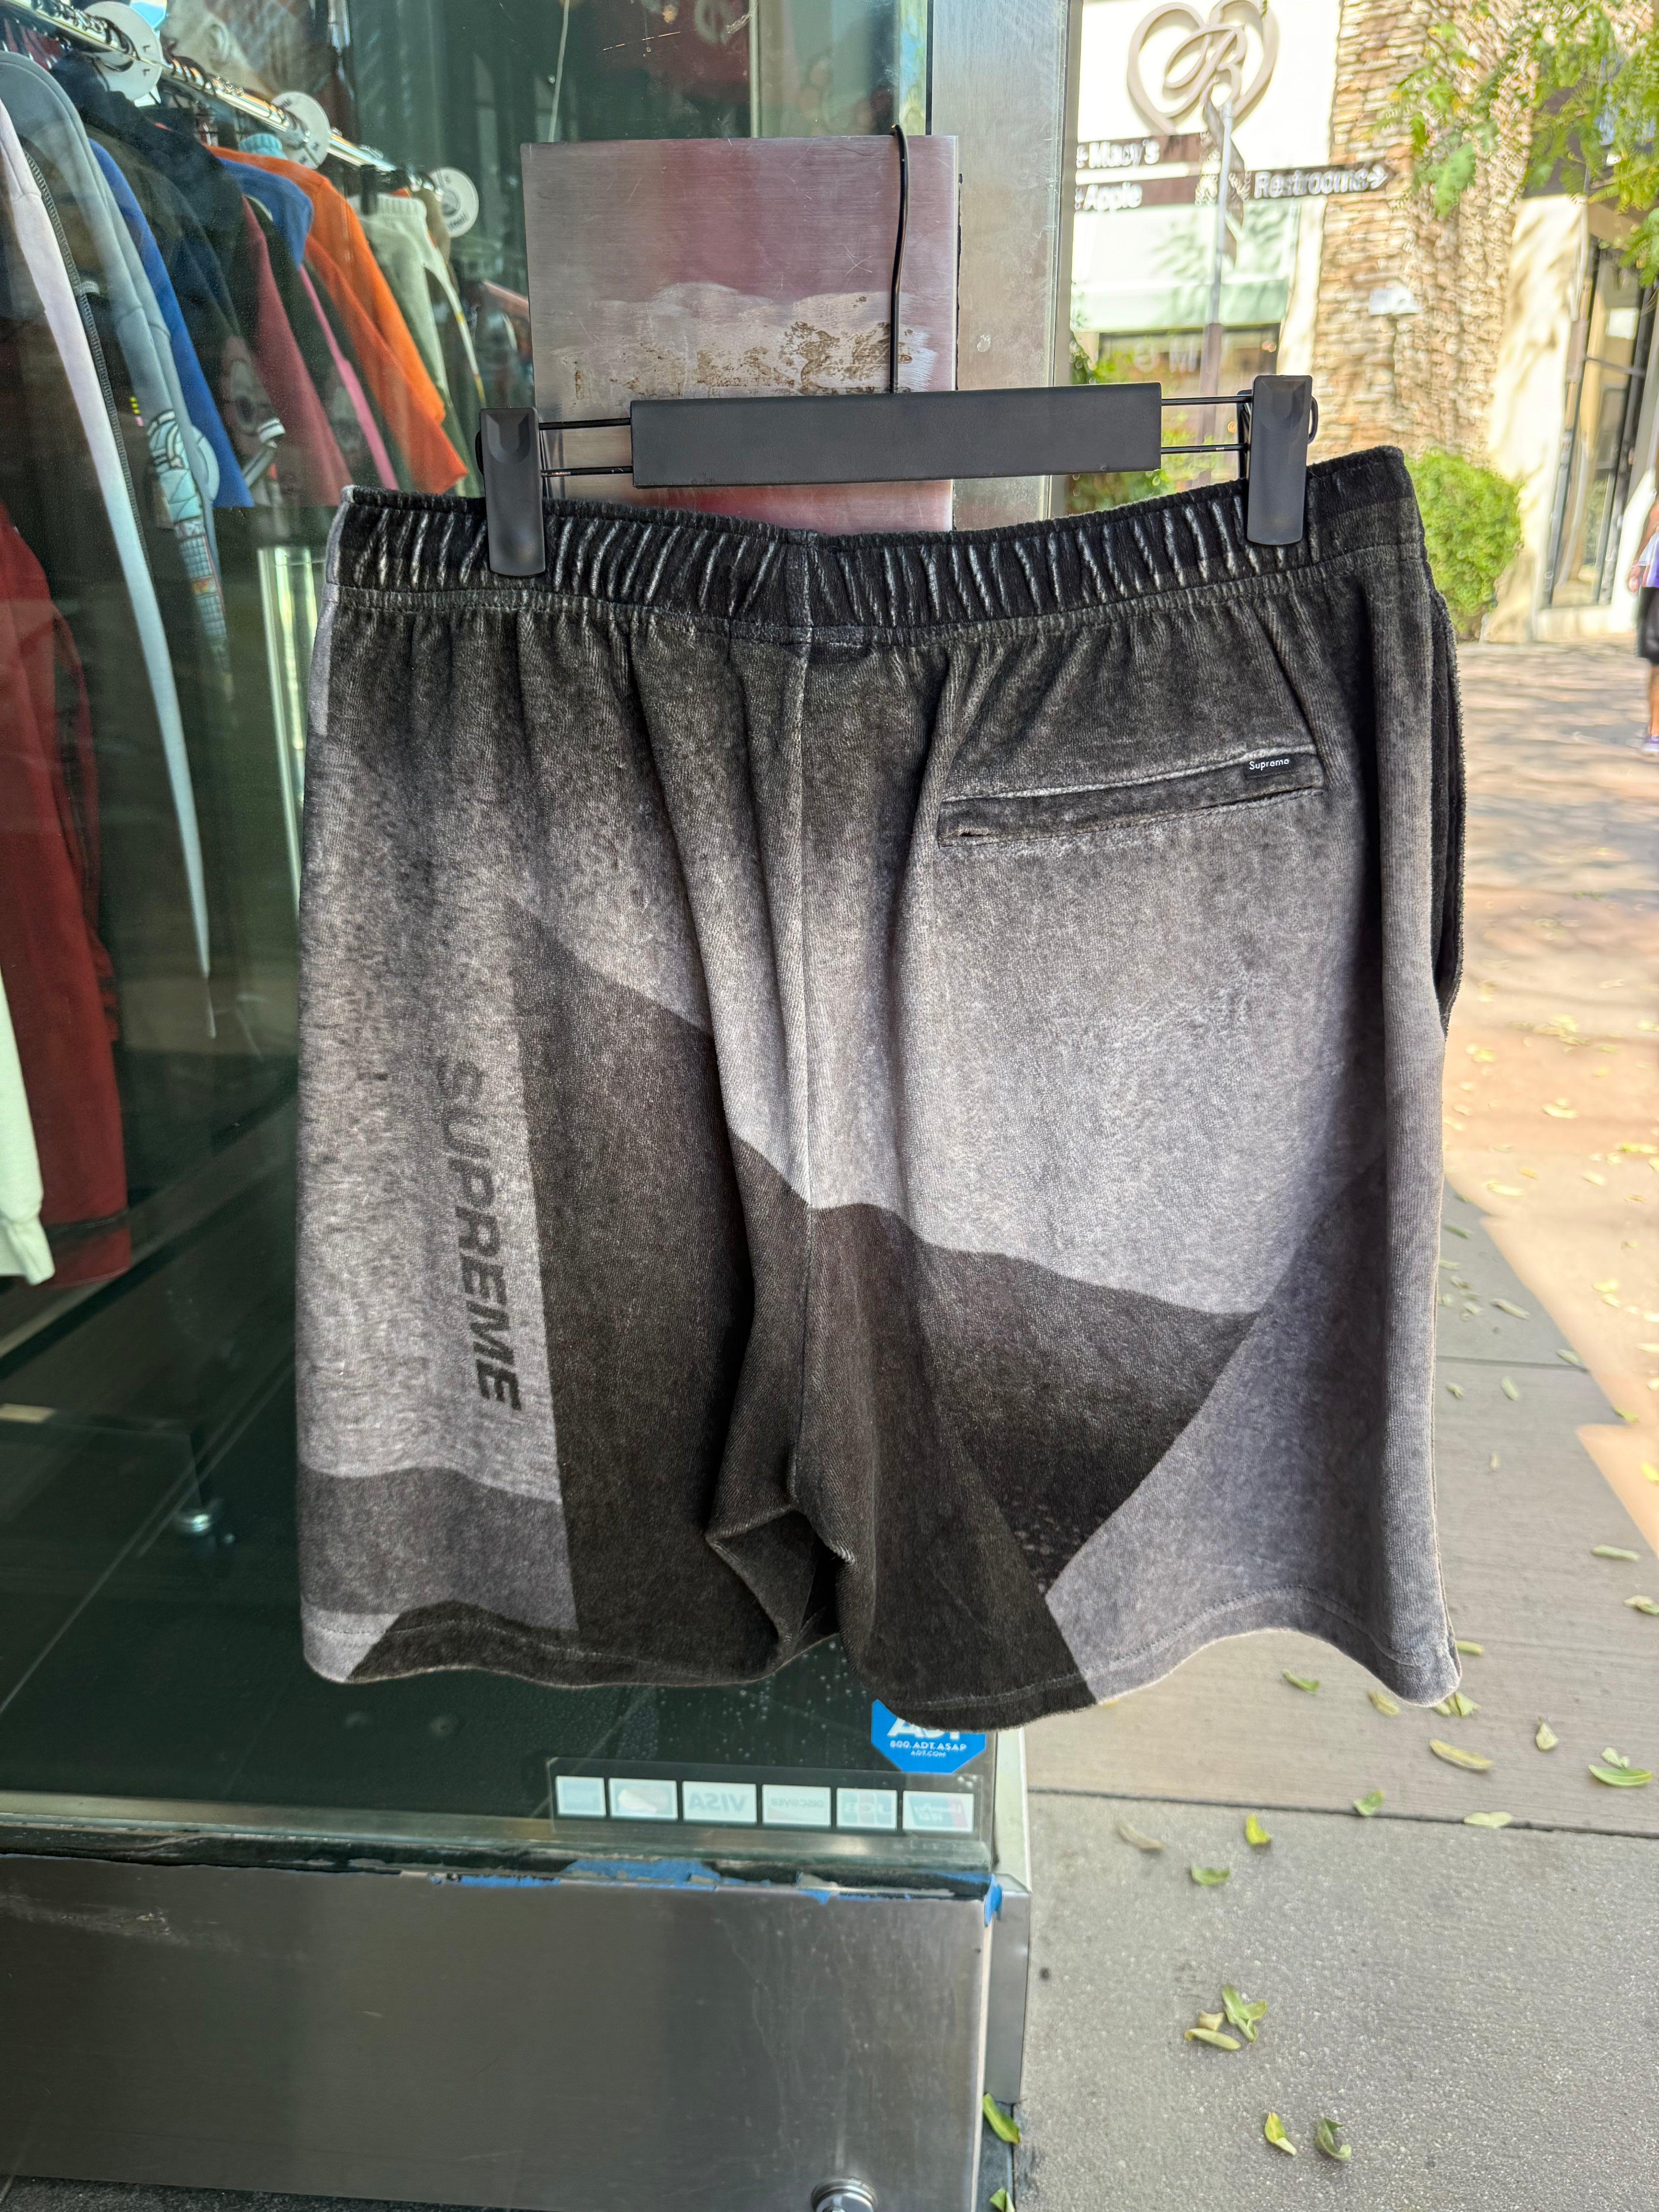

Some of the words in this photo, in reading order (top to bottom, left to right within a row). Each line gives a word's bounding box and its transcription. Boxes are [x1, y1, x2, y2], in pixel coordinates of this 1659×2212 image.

[1089, 140, 1160, 168] Macy's
[1083, 181, 1143, 212] Apple
[1254, 168, 1369, 199] Restrooms
[1249, 758, 1289, 771] Supreme
[437, 1058, 521, 1411] SUPREME
